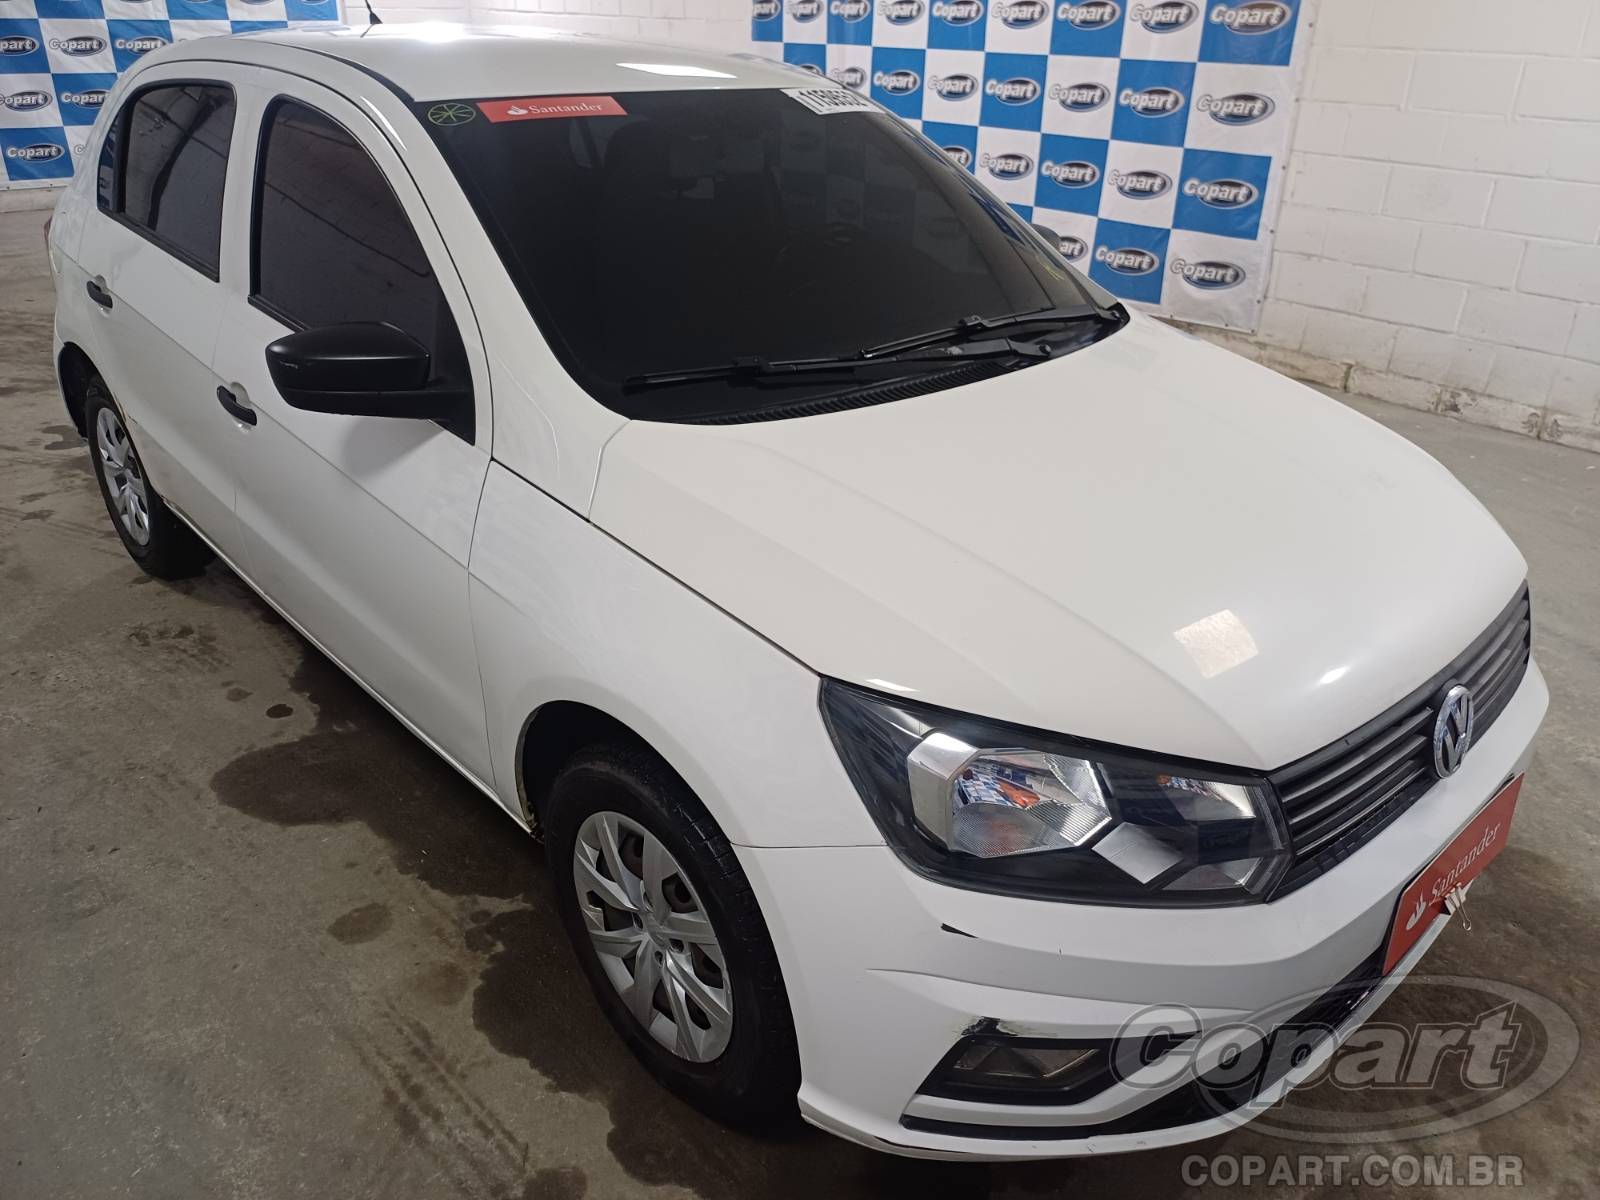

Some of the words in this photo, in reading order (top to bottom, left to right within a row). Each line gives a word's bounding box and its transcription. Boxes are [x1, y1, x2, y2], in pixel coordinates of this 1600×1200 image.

[752, 3, 777, 17] part
[831, 2, 865, 18] Copart
[878, 1, 918, 18] Copart
[933, 2, 978, 20] Copart
[992, 2, 1040, 22] Copart
[1057, 4, 1112, 24] Copart
[1130, 3, 1187, 25] Copart
[1211, 6, 1282, 28] Copart
[0, 39, 32, 52] part
[50, 38, 99, 51] Copart
[873, 72, 914, 89] Copart
[928, 76, 971, 93] Copart
[986, 80, 1035, 99] Copart
[61, 92, 106, 105] Copar
[1050, 84, 1102, 104] Copart
[1120, 90, 1174, 111] Copart
[528, 103, 603, 114] Santander
[1196, 95, 1264, 117] Copart
[7, 147, 59, 160] Copart
[980, 153, 1027, 172] Copart
[1041, 161, 1093, 181] Copart
[1108, 170, 1162, 192] Copart
[1184, 179, 1248, 202] Copart
[1059, 241, 1081, 256] art
[1096, 246, 1150, 268] Copart
[1171, 259, 1236, 282] Copart
[1429, 823, 1501, 905] Santander
